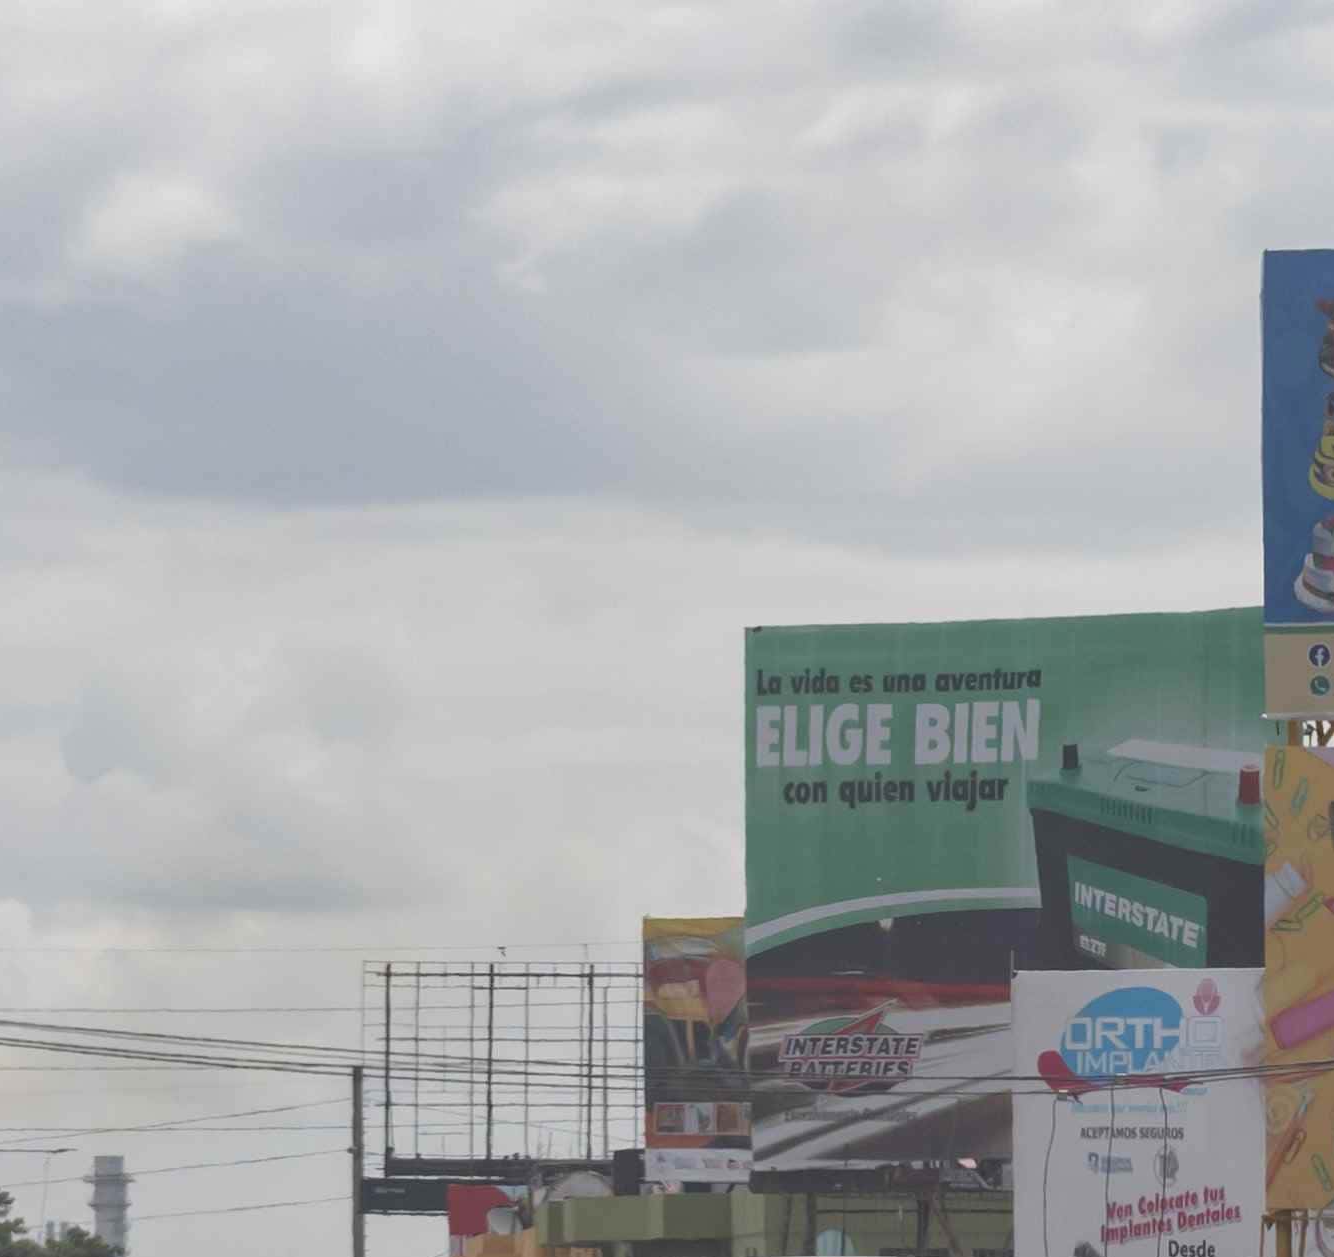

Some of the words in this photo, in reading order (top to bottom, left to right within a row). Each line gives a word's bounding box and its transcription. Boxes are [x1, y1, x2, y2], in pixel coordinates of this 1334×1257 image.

[757, 671, 781, 696] La
[791, 669, 840, 695] vida
[849, 672, 873, 693] es
[883, 672, 926, 693] una
[935, 668, 1042, 692] aventura
[754, 703, 893, 768] ELIGE
[914, 699, 1041, 765] BIEN
[783, 778, 828, 804] con
[839, 772, 915, 811] quien
[926, 770, 1009, 811] viajar
[1074, 881, 1201, 948] INTERSTATE
[785, 1036, 919, 1056] INTERSTATE
[1067, 1016, 1222, 1050] ORTHO
[790, 1060, 910, 1076] BATTERIES
[1080, 1126, 1137, 1140] ACEPTAMOS
[1139, 1126, 1185, 1140] SEGUROS
[1203, 1185, 1226, 1202] tus
[1101, 1214, 1173, 1245] Implantes
[1178, 1203, 1242, 1230] Dentales
